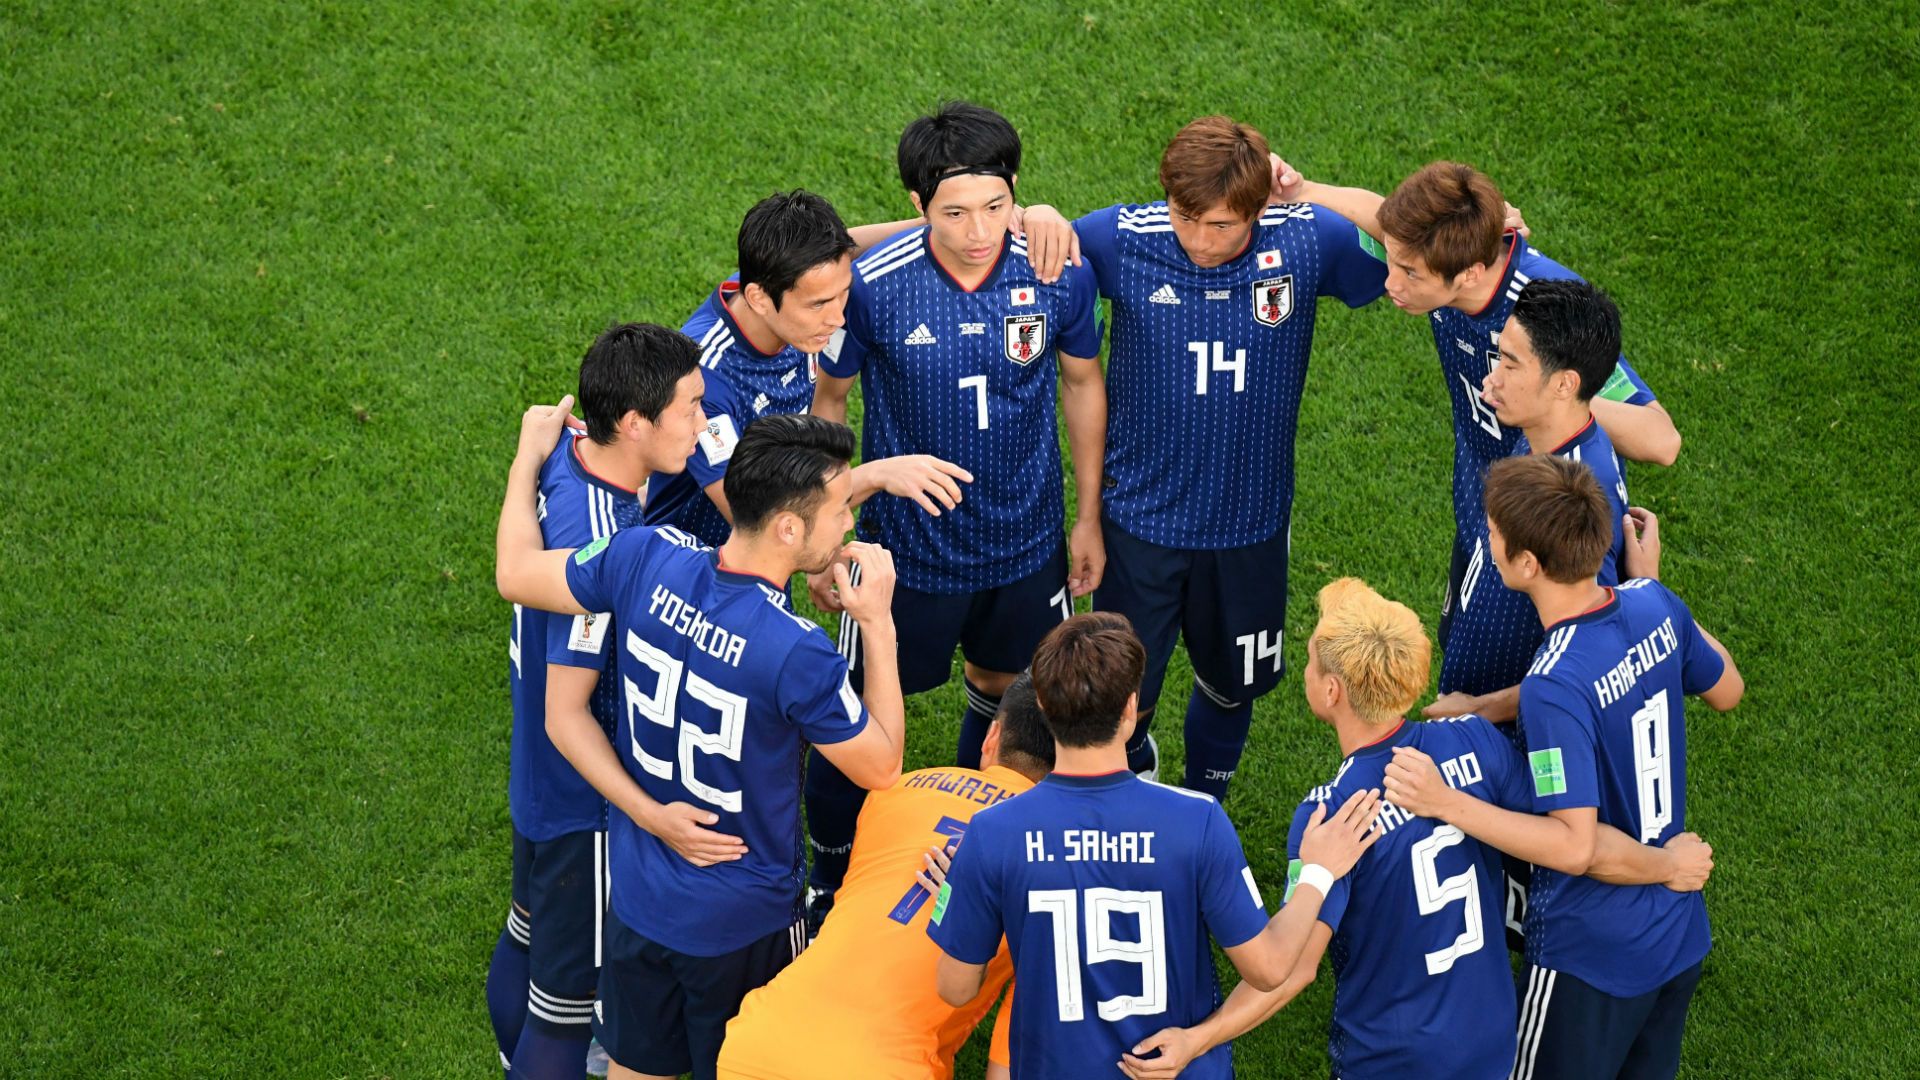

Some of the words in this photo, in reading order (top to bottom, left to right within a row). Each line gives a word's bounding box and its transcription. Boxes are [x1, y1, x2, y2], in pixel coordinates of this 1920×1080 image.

[1149, 294, 1181, 304] adidas
[904, 336, 937, 345] adidas
[1188, 341, 1246, 395] 14
[958, 375, 989, 430] 7
[649, 584, 748, 668] YOSHIDA
[1236, 629, 1283, 687] 14
[624, 628, 748, 813] 22
[1631, 688, 1672, 844] 8
[1025, 830, 1054, 862] H.
[1064, 829, 1156, 863] SAKAI
[1411, 823, 1485, 976] 5
[1028, 887, 1158, 1022] 19
